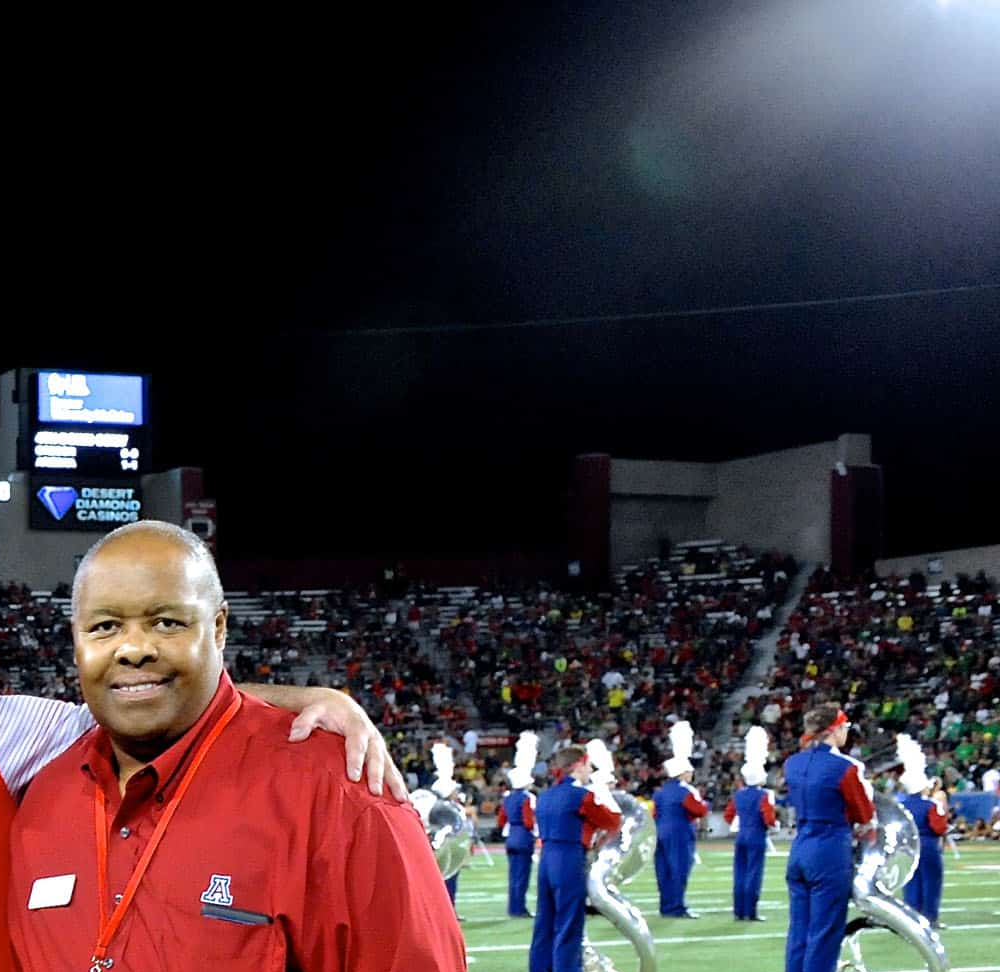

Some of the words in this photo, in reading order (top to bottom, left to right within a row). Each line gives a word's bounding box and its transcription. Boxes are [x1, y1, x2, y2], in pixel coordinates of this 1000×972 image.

[81, 487, 135, 500] DESERT
[75, 499, 141, 511] DIAMOND
[76, 510, 138, 522] CASINOS
[200, 874, 233, 906] A
